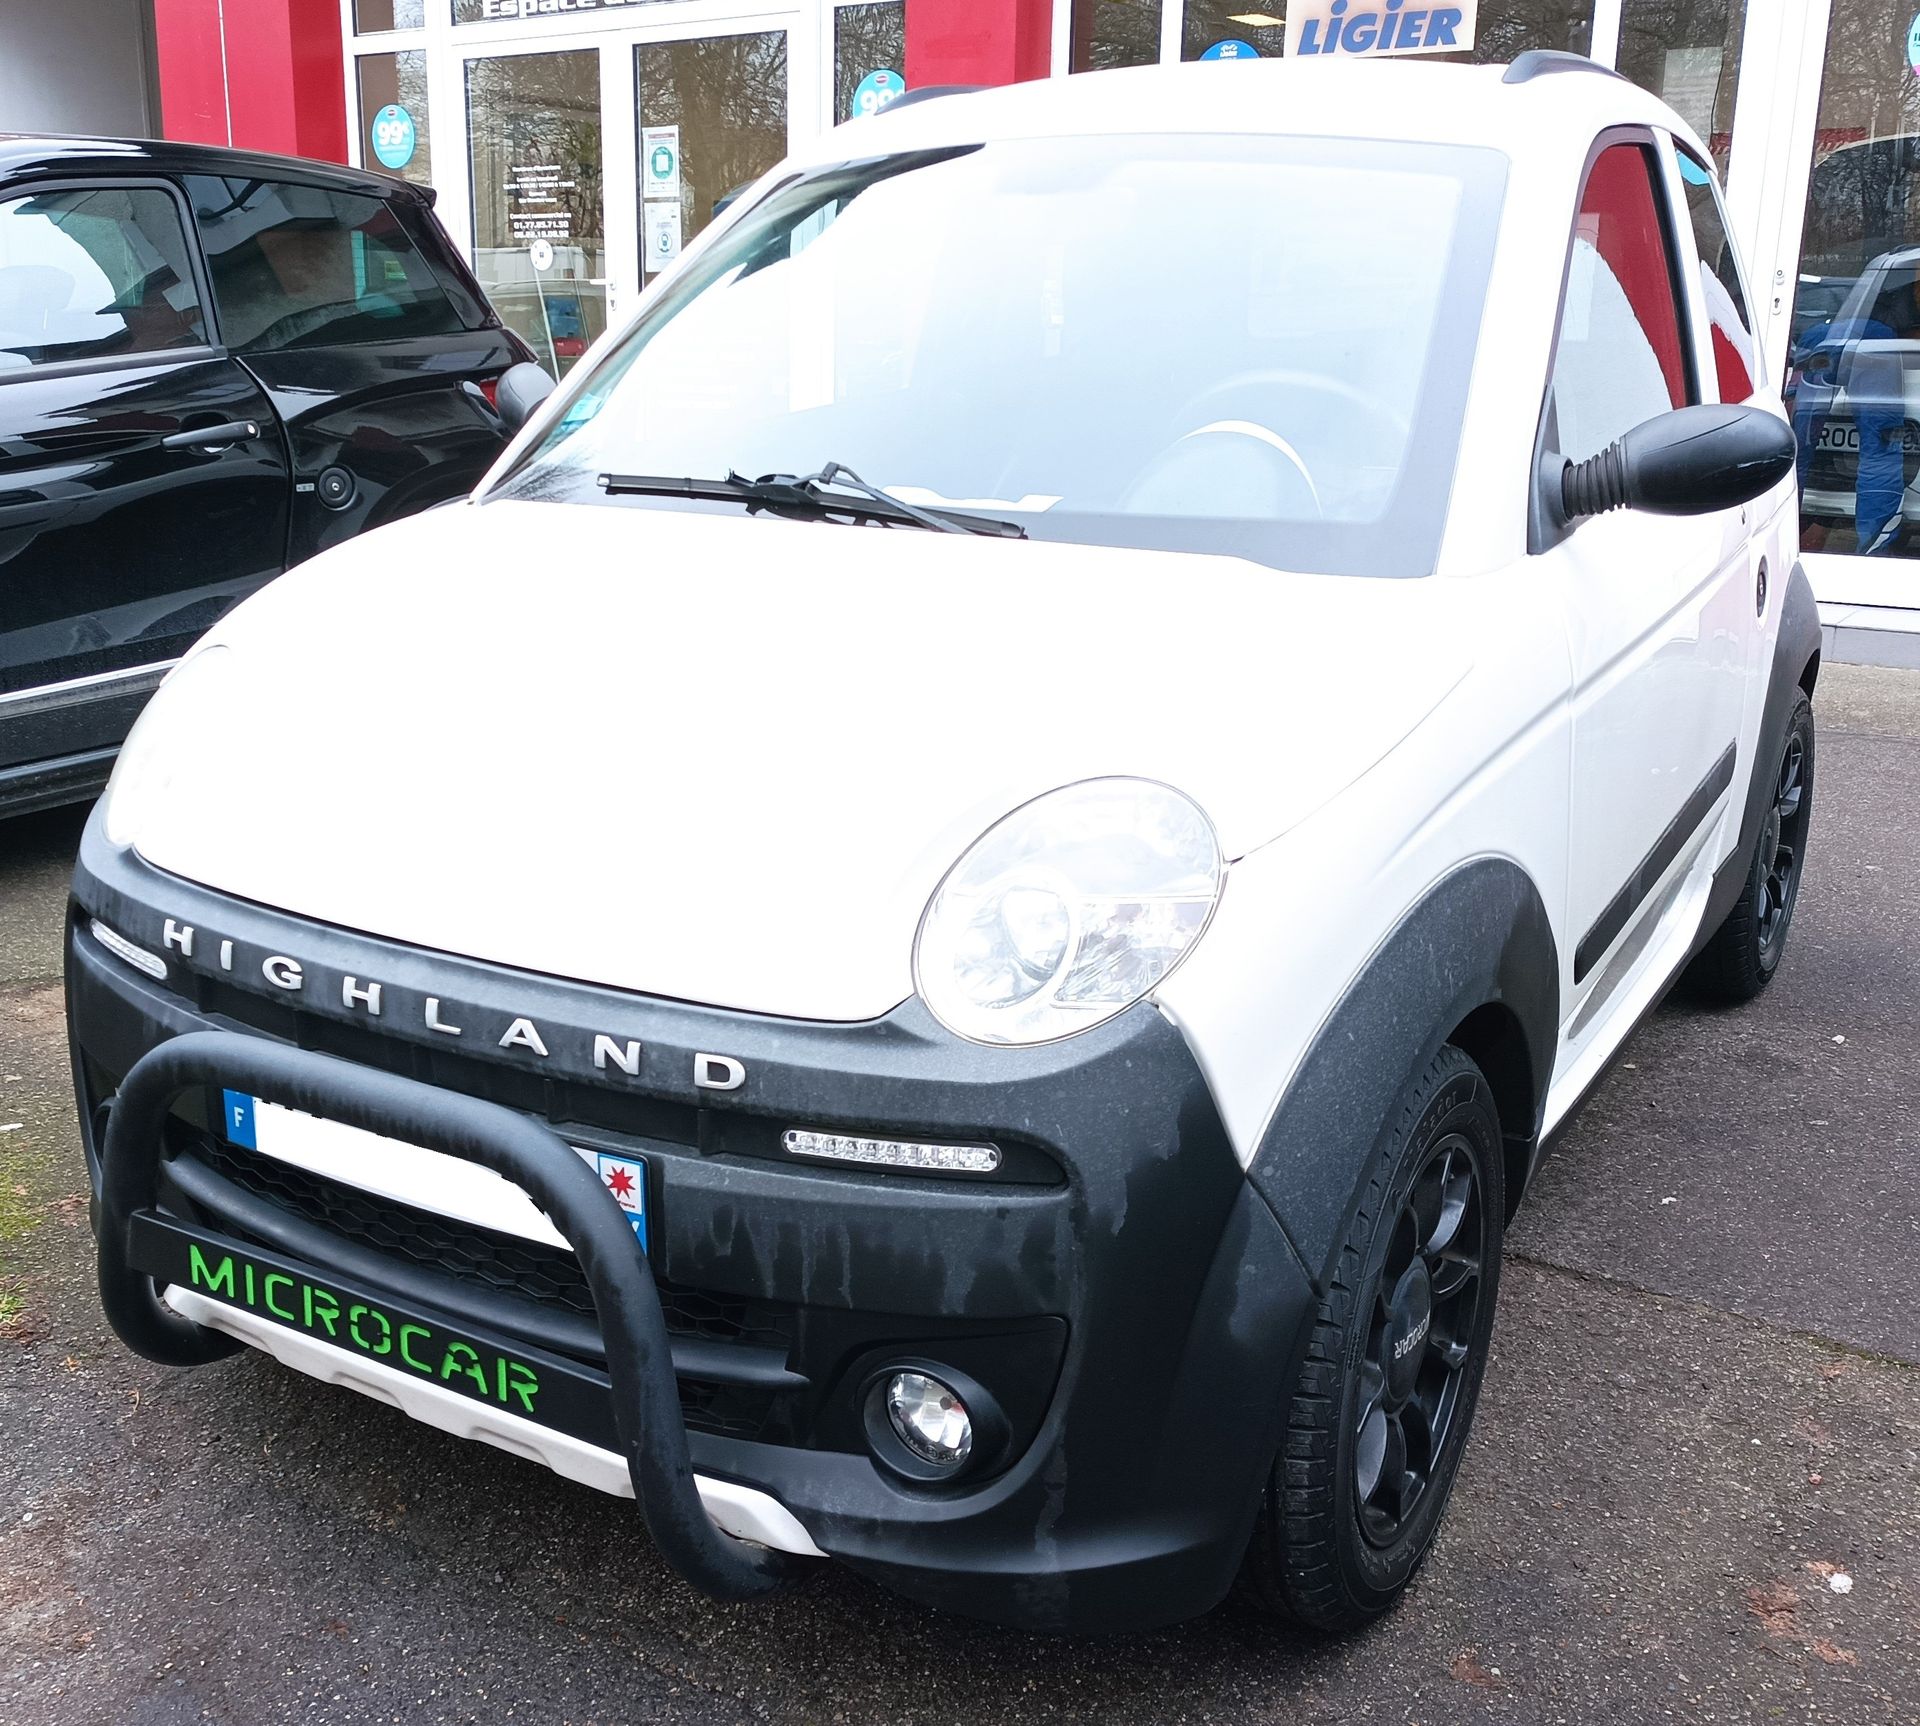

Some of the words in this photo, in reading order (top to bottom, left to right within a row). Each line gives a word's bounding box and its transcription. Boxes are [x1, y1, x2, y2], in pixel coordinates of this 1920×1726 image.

[162, 918, 746, 1091] HIGHLAND
[233, 1105, 245, 1128] F
[189, 1243, 539, 1413] MICROCAR
